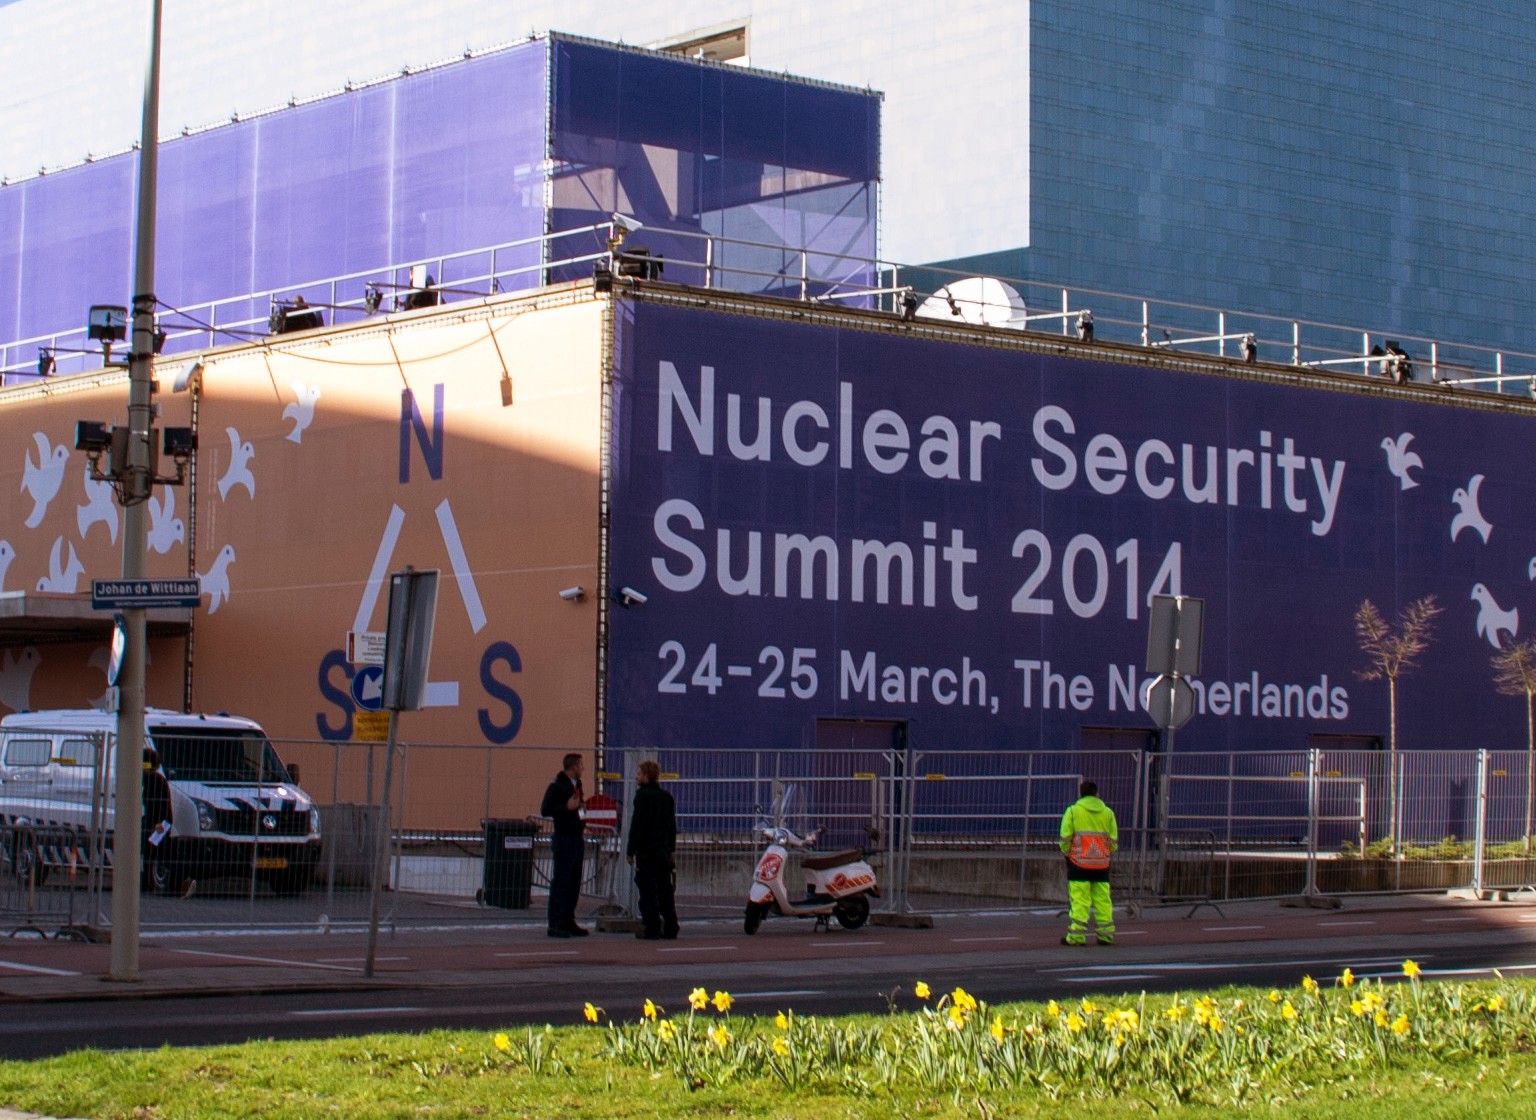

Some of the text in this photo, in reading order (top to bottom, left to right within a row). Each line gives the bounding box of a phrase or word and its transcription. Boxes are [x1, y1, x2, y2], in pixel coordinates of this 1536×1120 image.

[399, 383, 444, 484] N
[658, 360, 1346, 536] Nuclear Security
[98, 582, 197, 595] Johan de Wittlaan
[651, 498, 978, 611] Summit
[316, 640, 523, 745] S S
[658, 640, 818, 699] 24-25
[840, 649, 999, 714] March,
[1014, 659, 1094, 711] The
